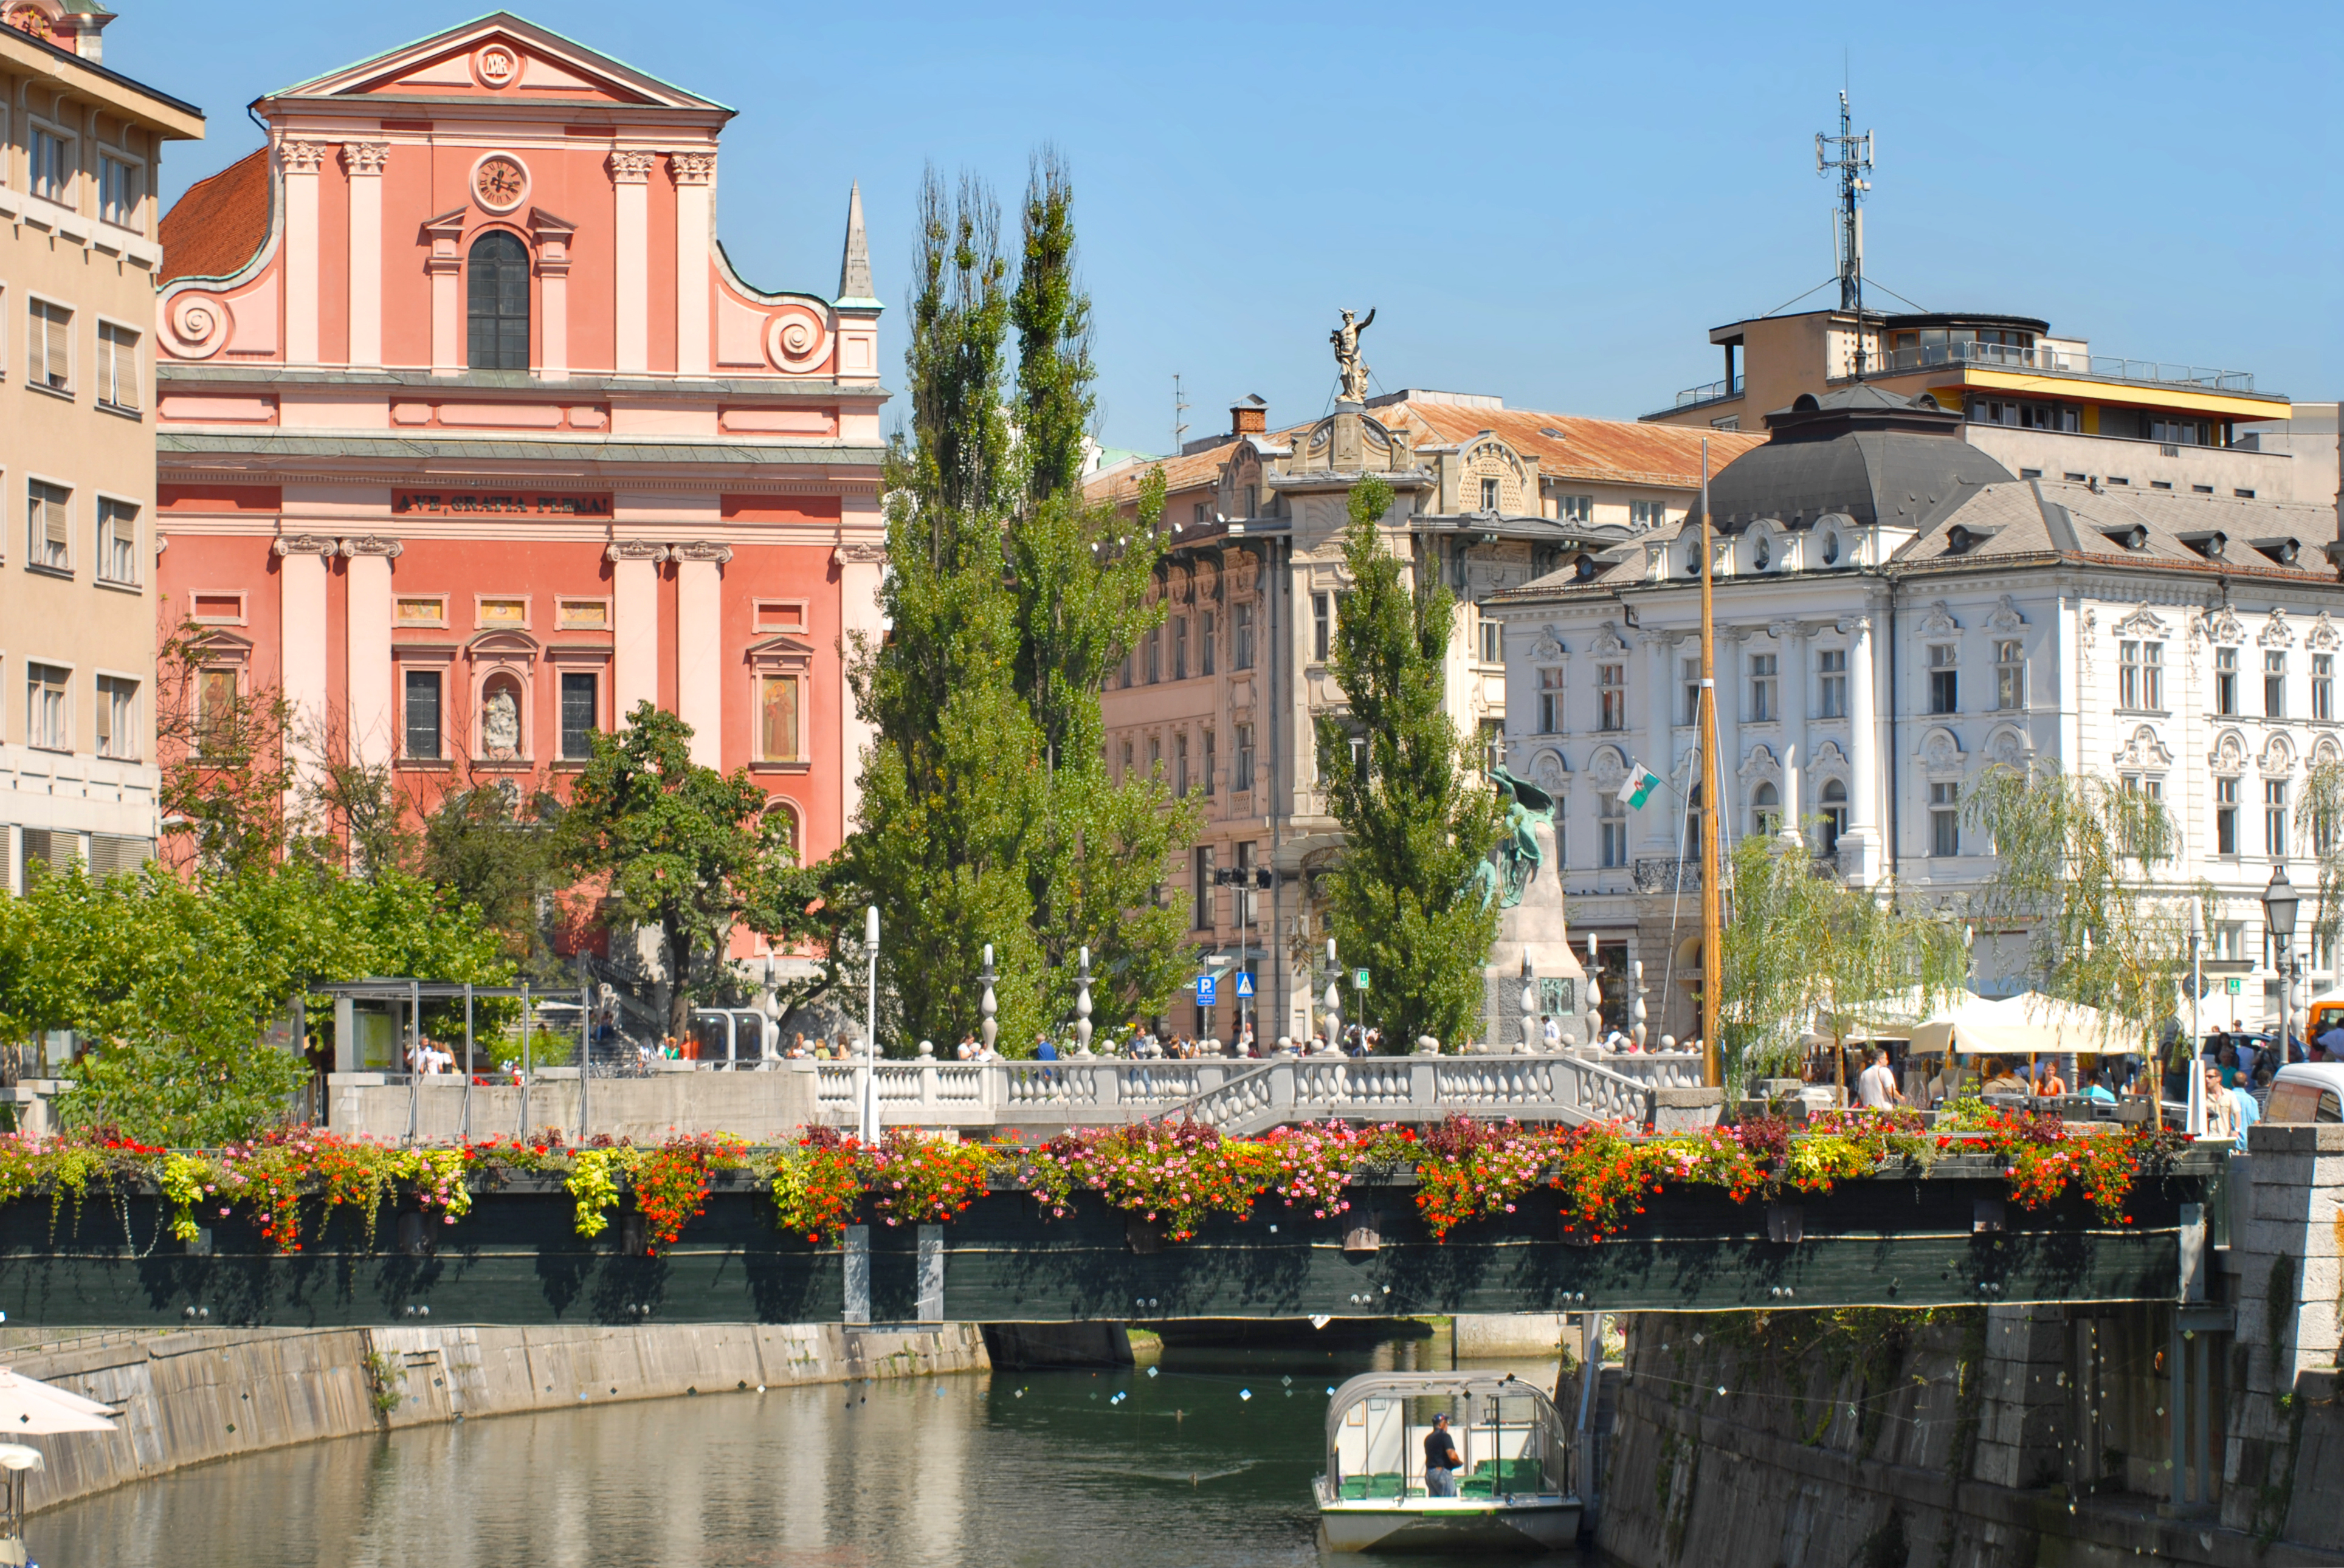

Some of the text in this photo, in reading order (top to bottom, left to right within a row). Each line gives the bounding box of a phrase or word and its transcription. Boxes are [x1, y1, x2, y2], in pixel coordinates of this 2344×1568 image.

[451, 496, 528, 513] GRATIA
[537, 497, 607, 514] PLENA!
[1201, 978, 1211, 993] P
